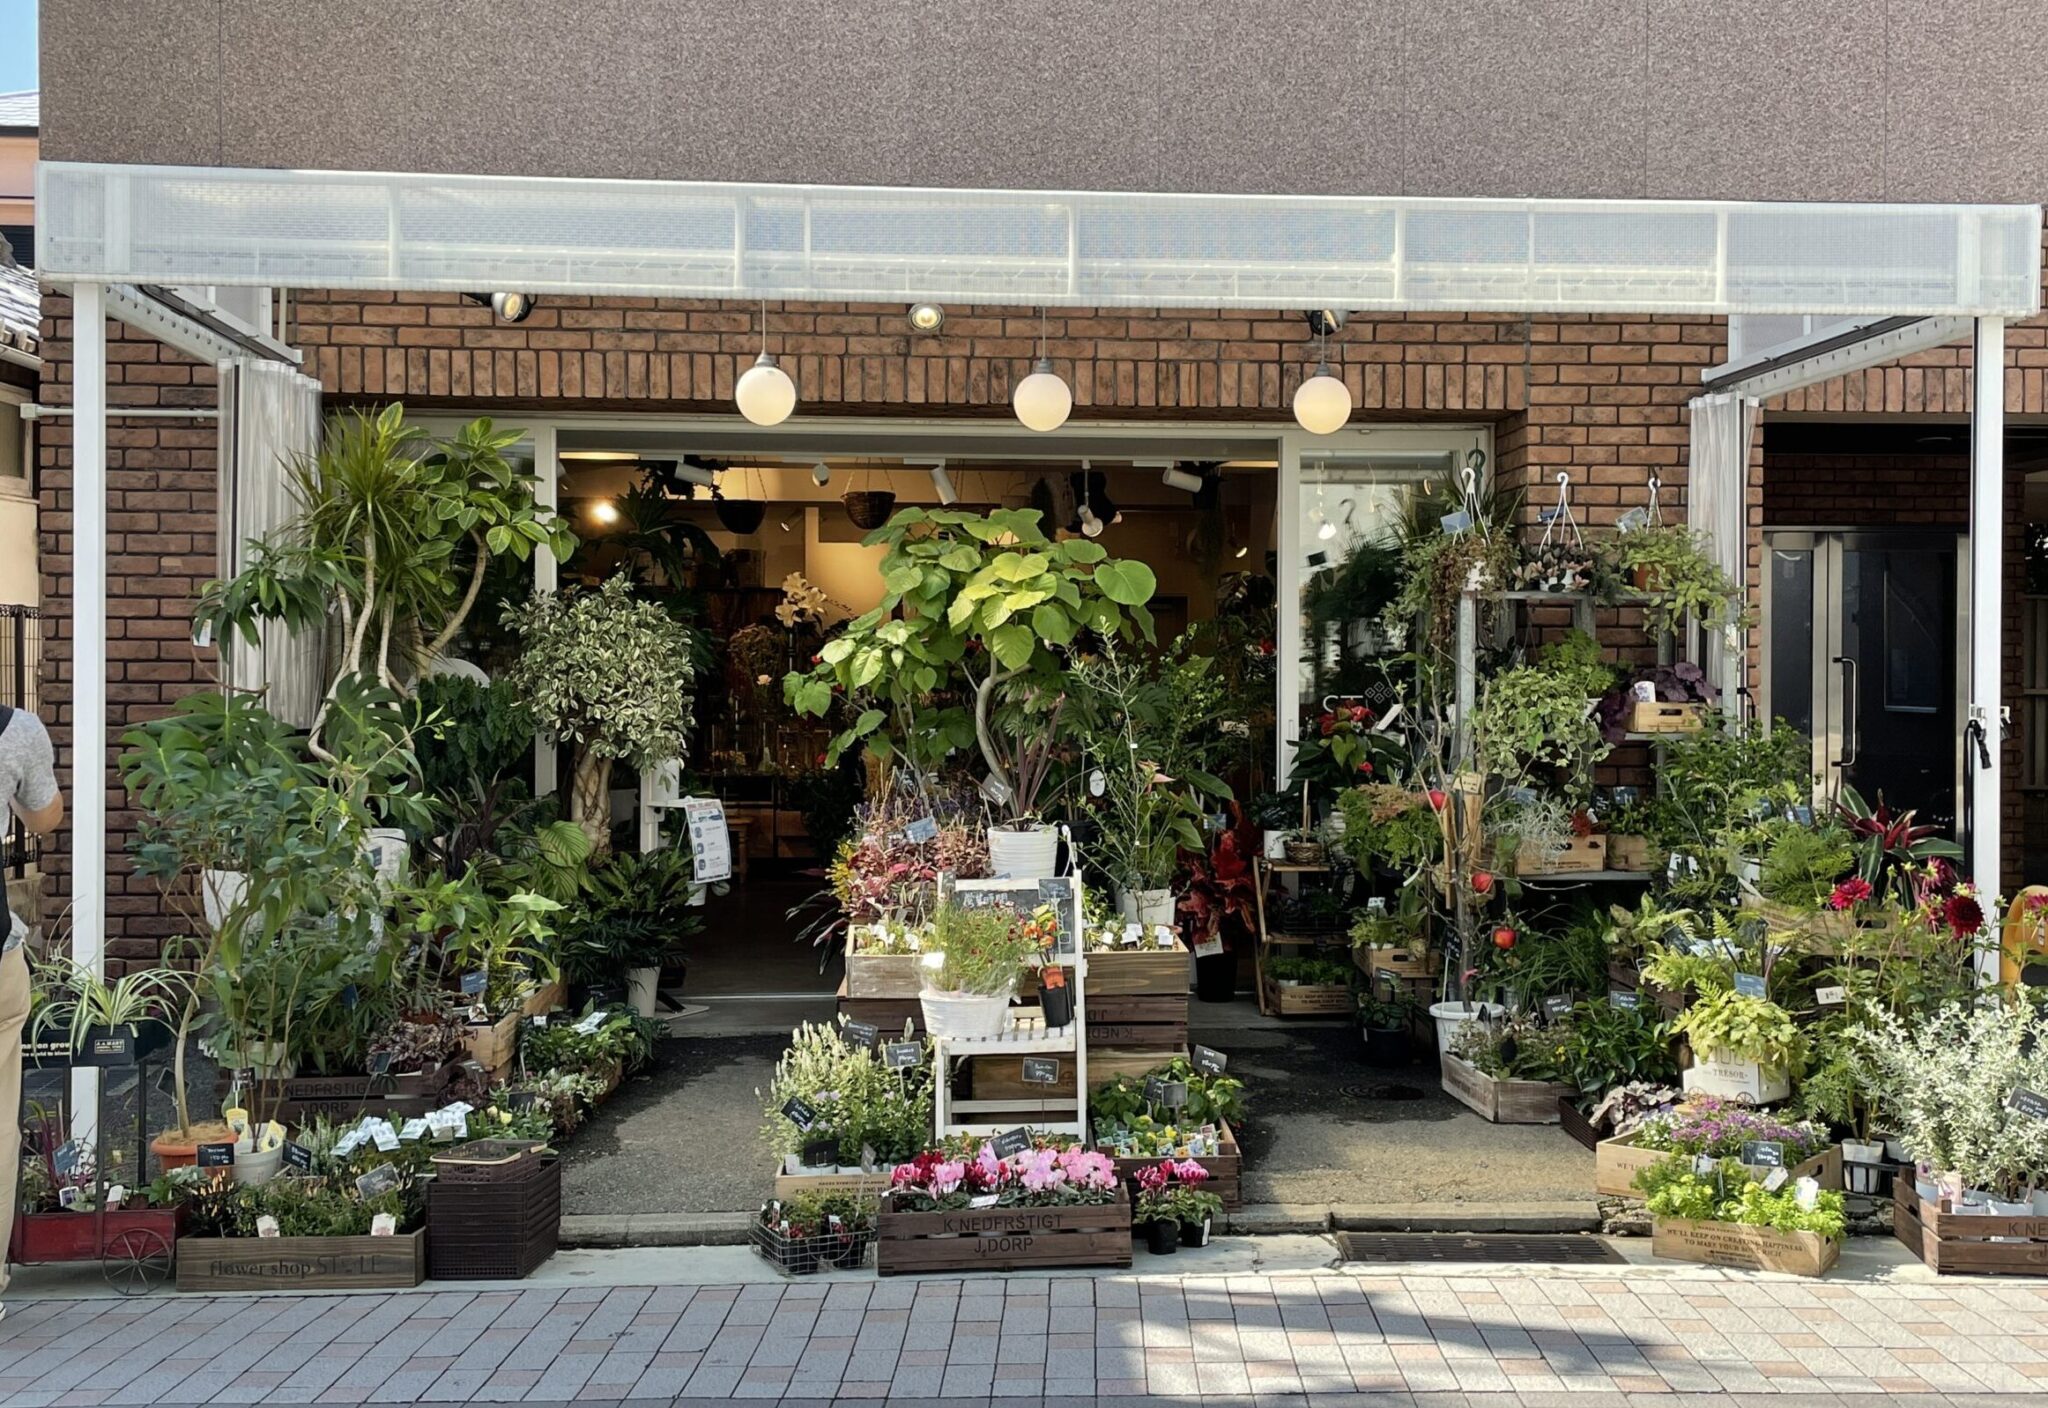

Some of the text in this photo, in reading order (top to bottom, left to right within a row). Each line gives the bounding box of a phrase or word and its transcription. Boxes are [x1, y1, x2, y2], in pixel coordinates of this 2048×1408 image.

[1690, 1231, 1709, 1240] KEEP
[1718, 1243, 1739, 1251] YOUR
[210, 1259, 264, 1276] flower
[271, 1258, 312, 1279] shop
